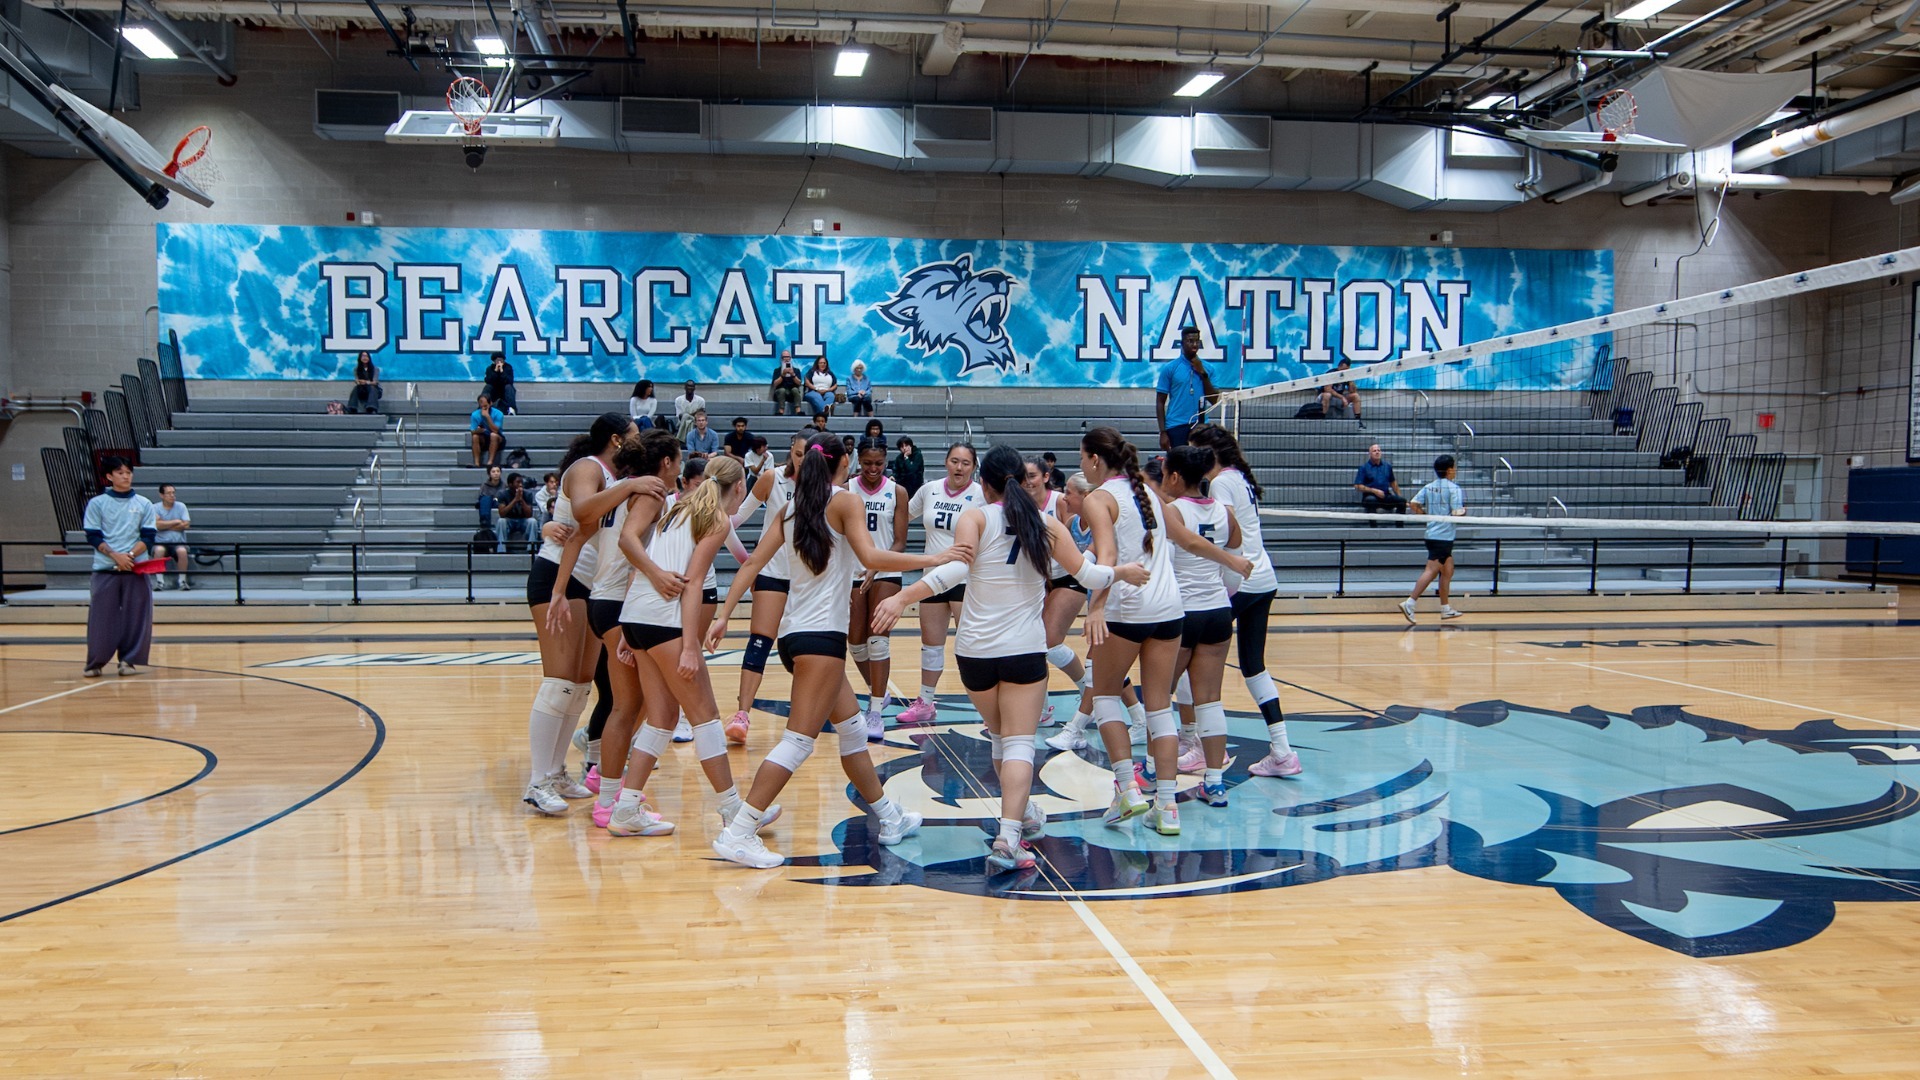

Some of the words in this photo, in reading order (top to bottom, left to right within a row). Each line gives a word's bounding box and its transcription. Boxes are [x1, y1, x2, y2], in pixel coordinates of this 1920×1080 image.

[319, 261, 846, 358] BEARCAT
[1075, 273, 1471, 364] NATION
[865, 501, 886, 512] RUCH
[933, 501, 963, 512] BARUCH
[867, 512, 878, 532] 8
[934, 511, 953, 531] 21
[1005, 526, 1021, 565] 7
